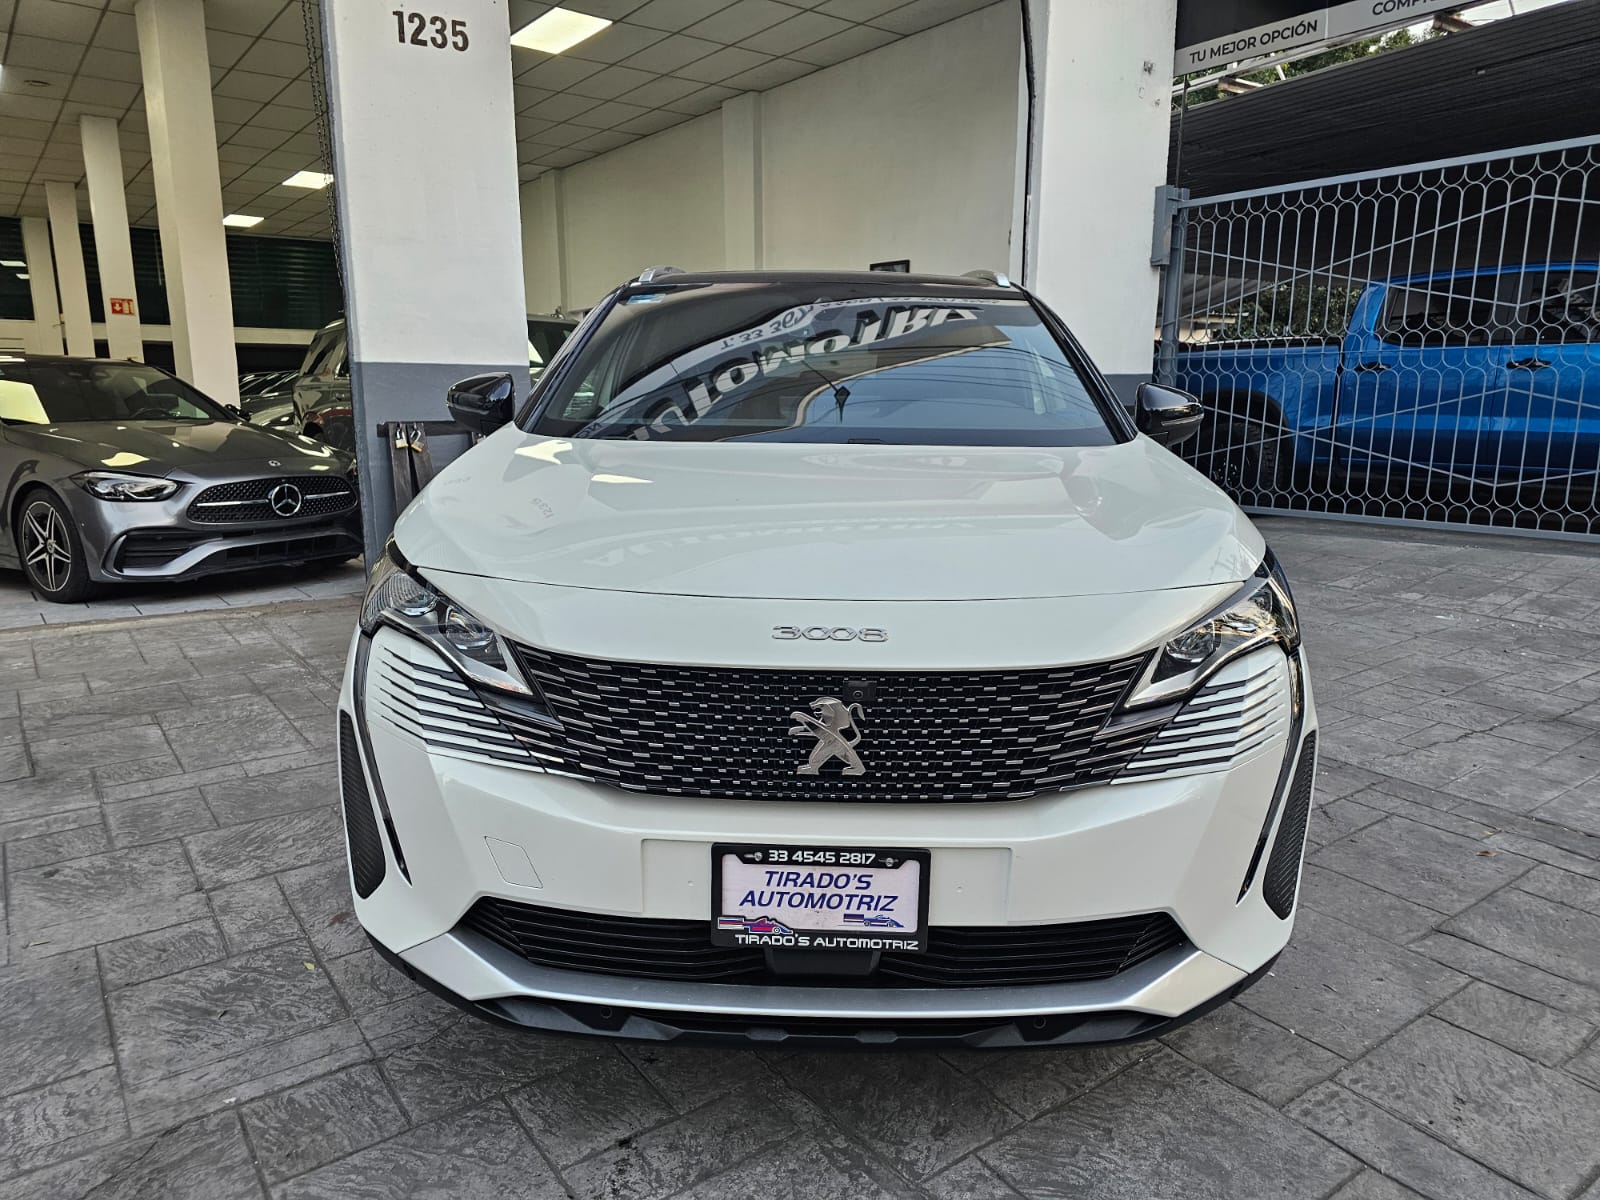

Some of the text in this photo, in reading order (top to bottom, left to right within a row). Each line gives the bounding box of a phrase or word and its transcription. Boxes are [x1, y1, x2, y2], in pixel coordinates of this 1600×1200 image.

[392, 10, 469, 52] 1235
[1189, 19, 1318, 64] TU MEJOR OPCIÓN
[772, 626, 888, 642] 3008
[768, 850, 876, 865] 33 4545 2817
[764, 870, 874, 890] TIRADO'S
[739, 890, 899, 912] AUTOMOTRIZ
[734, 933, 811, 947] TIRADO'S
[813, 936, 919, 950] AUTOMOTRIZ
